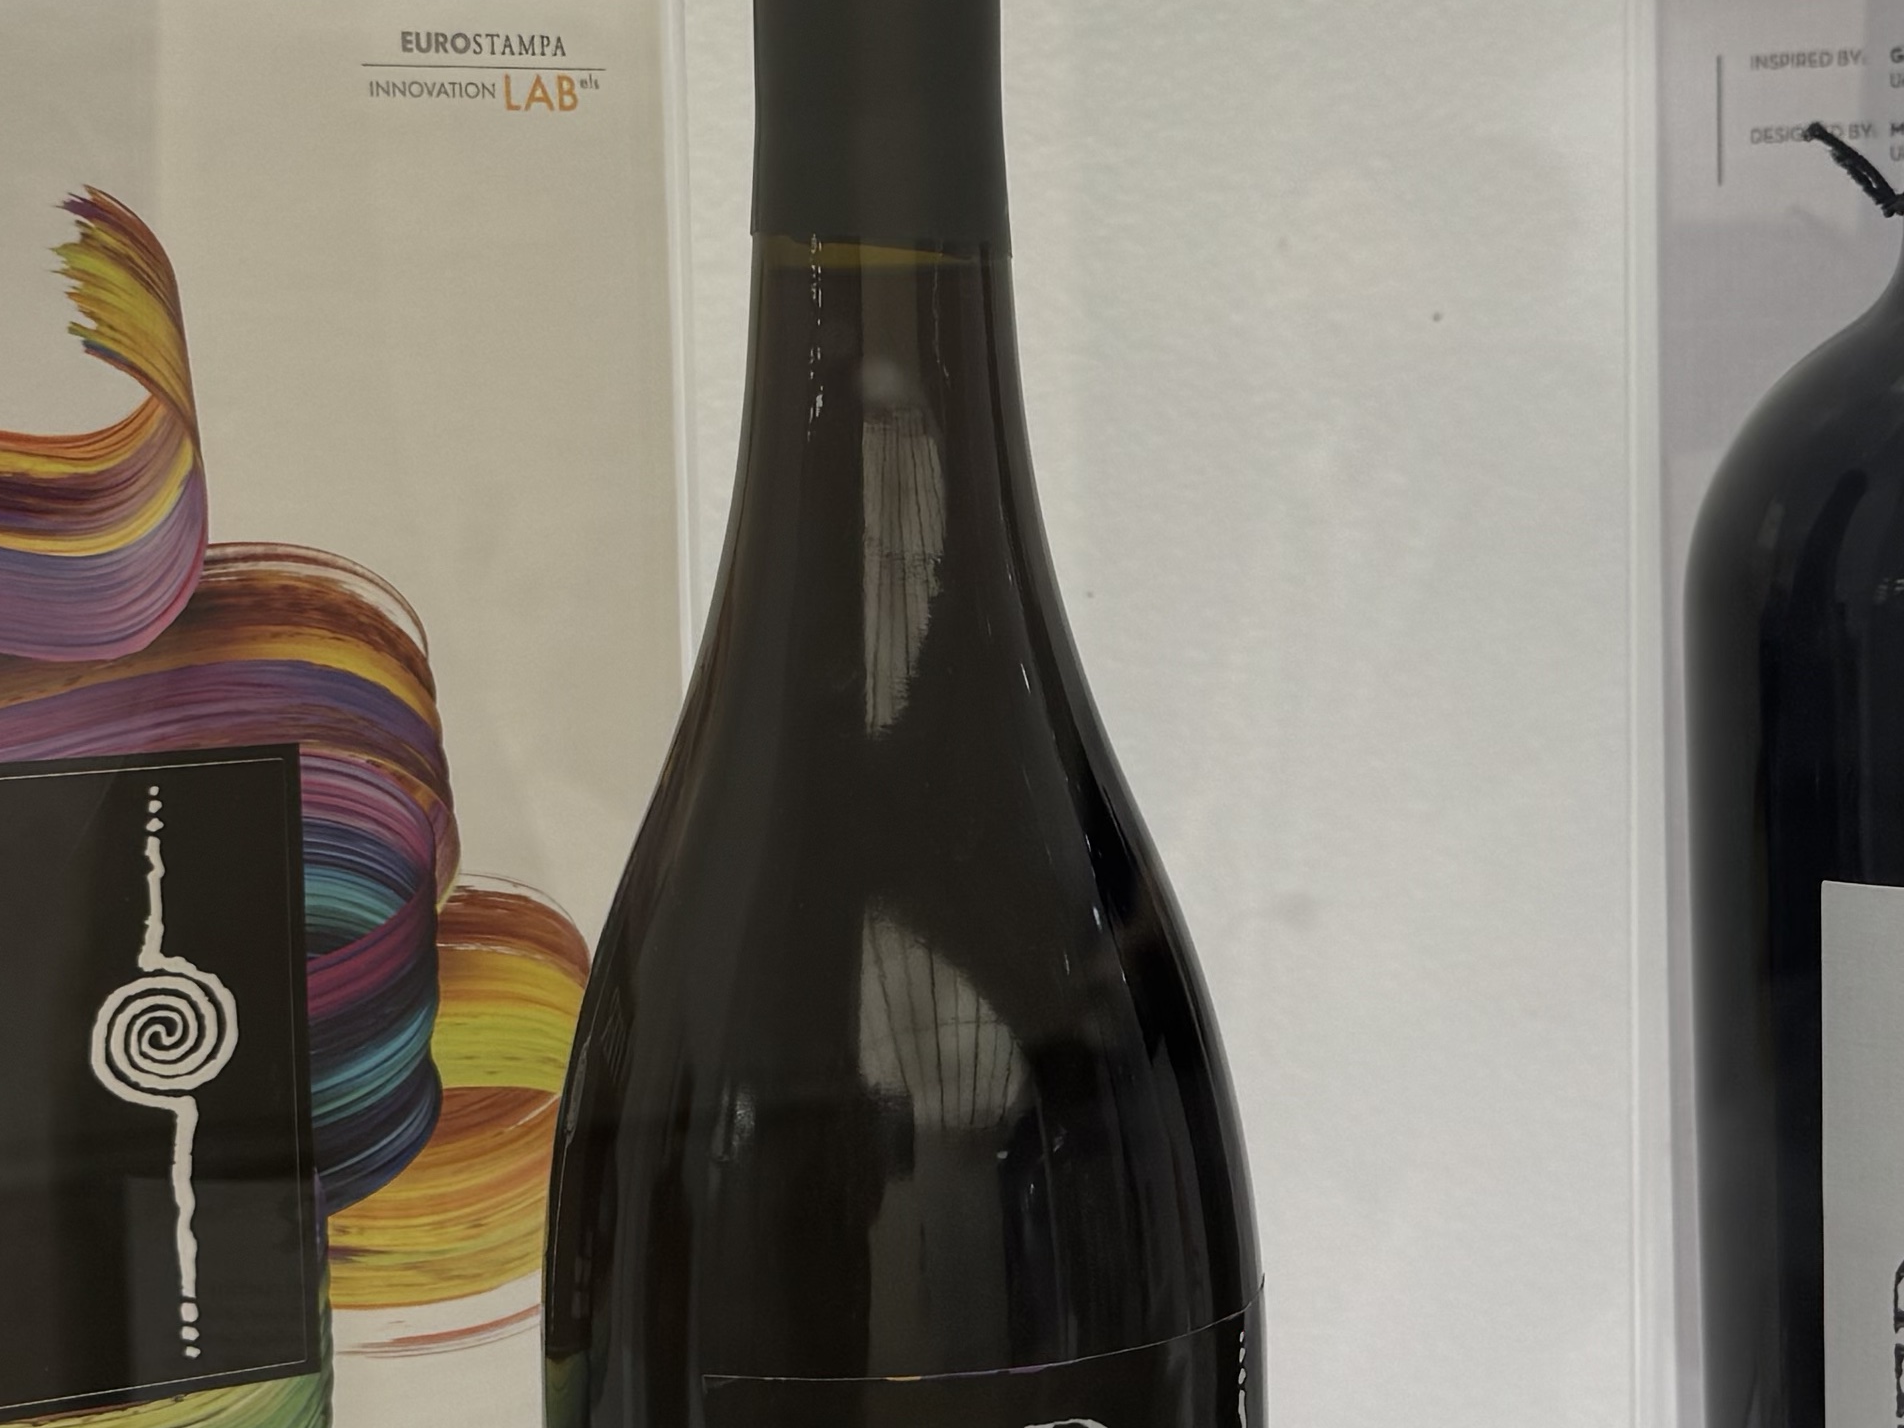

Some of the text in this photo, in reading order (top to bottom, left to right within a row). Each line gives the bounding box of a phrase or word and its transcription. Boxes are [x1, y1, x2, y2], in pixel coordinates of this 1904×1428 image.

[400, 30, 566, 57] EUROSTAMPA
[368, 80, 495, 99] INNOVATION
[1750, 123, 1844, 144] DESIGD
